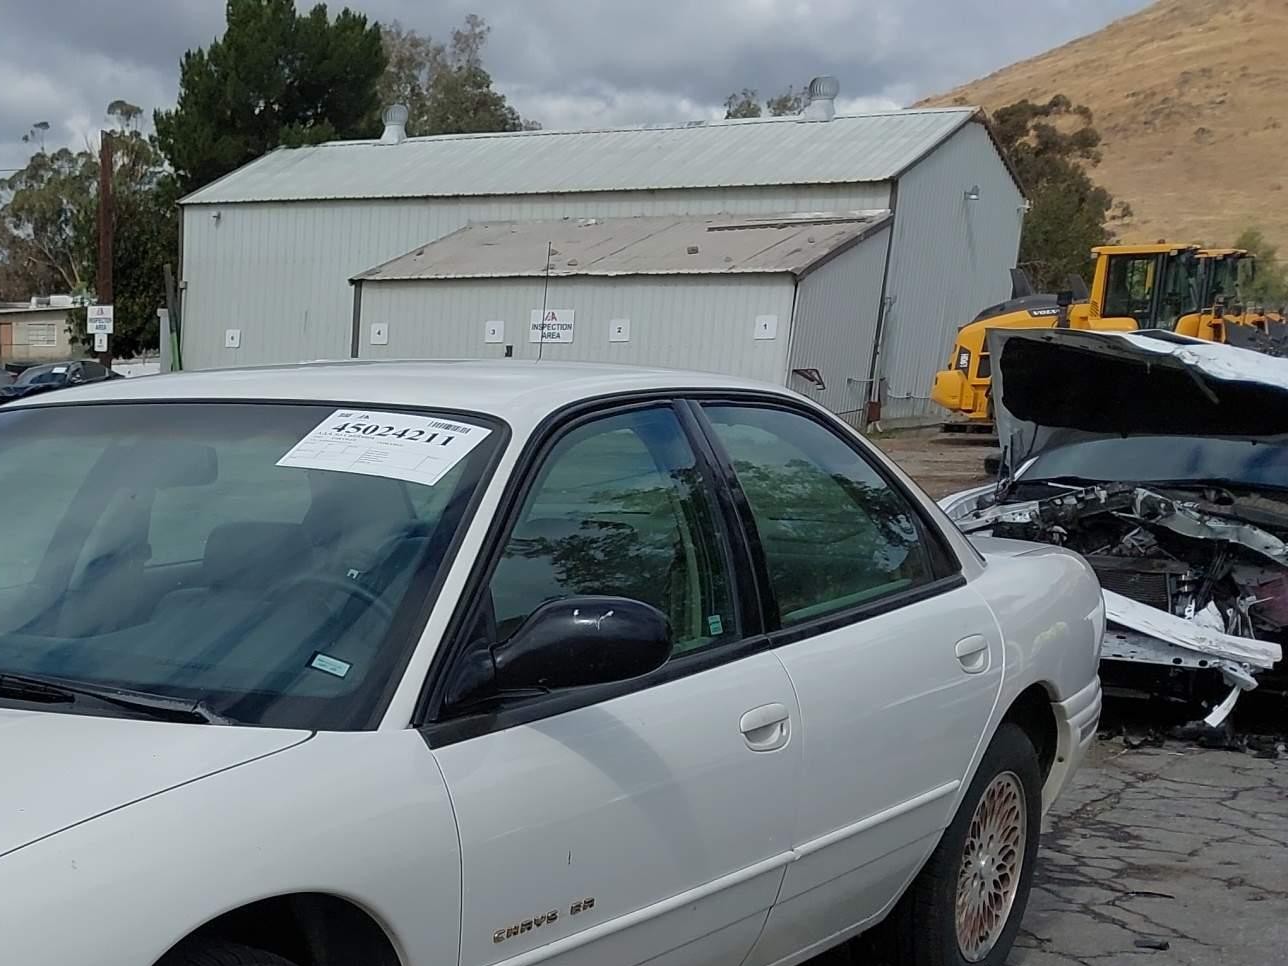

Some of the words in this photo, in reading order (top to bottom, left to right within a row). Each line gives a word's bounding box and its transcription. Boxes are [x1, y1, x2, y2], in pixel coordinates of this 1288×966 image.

[531, 323, 572, 331] INSPECTION
[542, 331, 561, 339] AREA
[332, 422, 455, 446] 45024211
